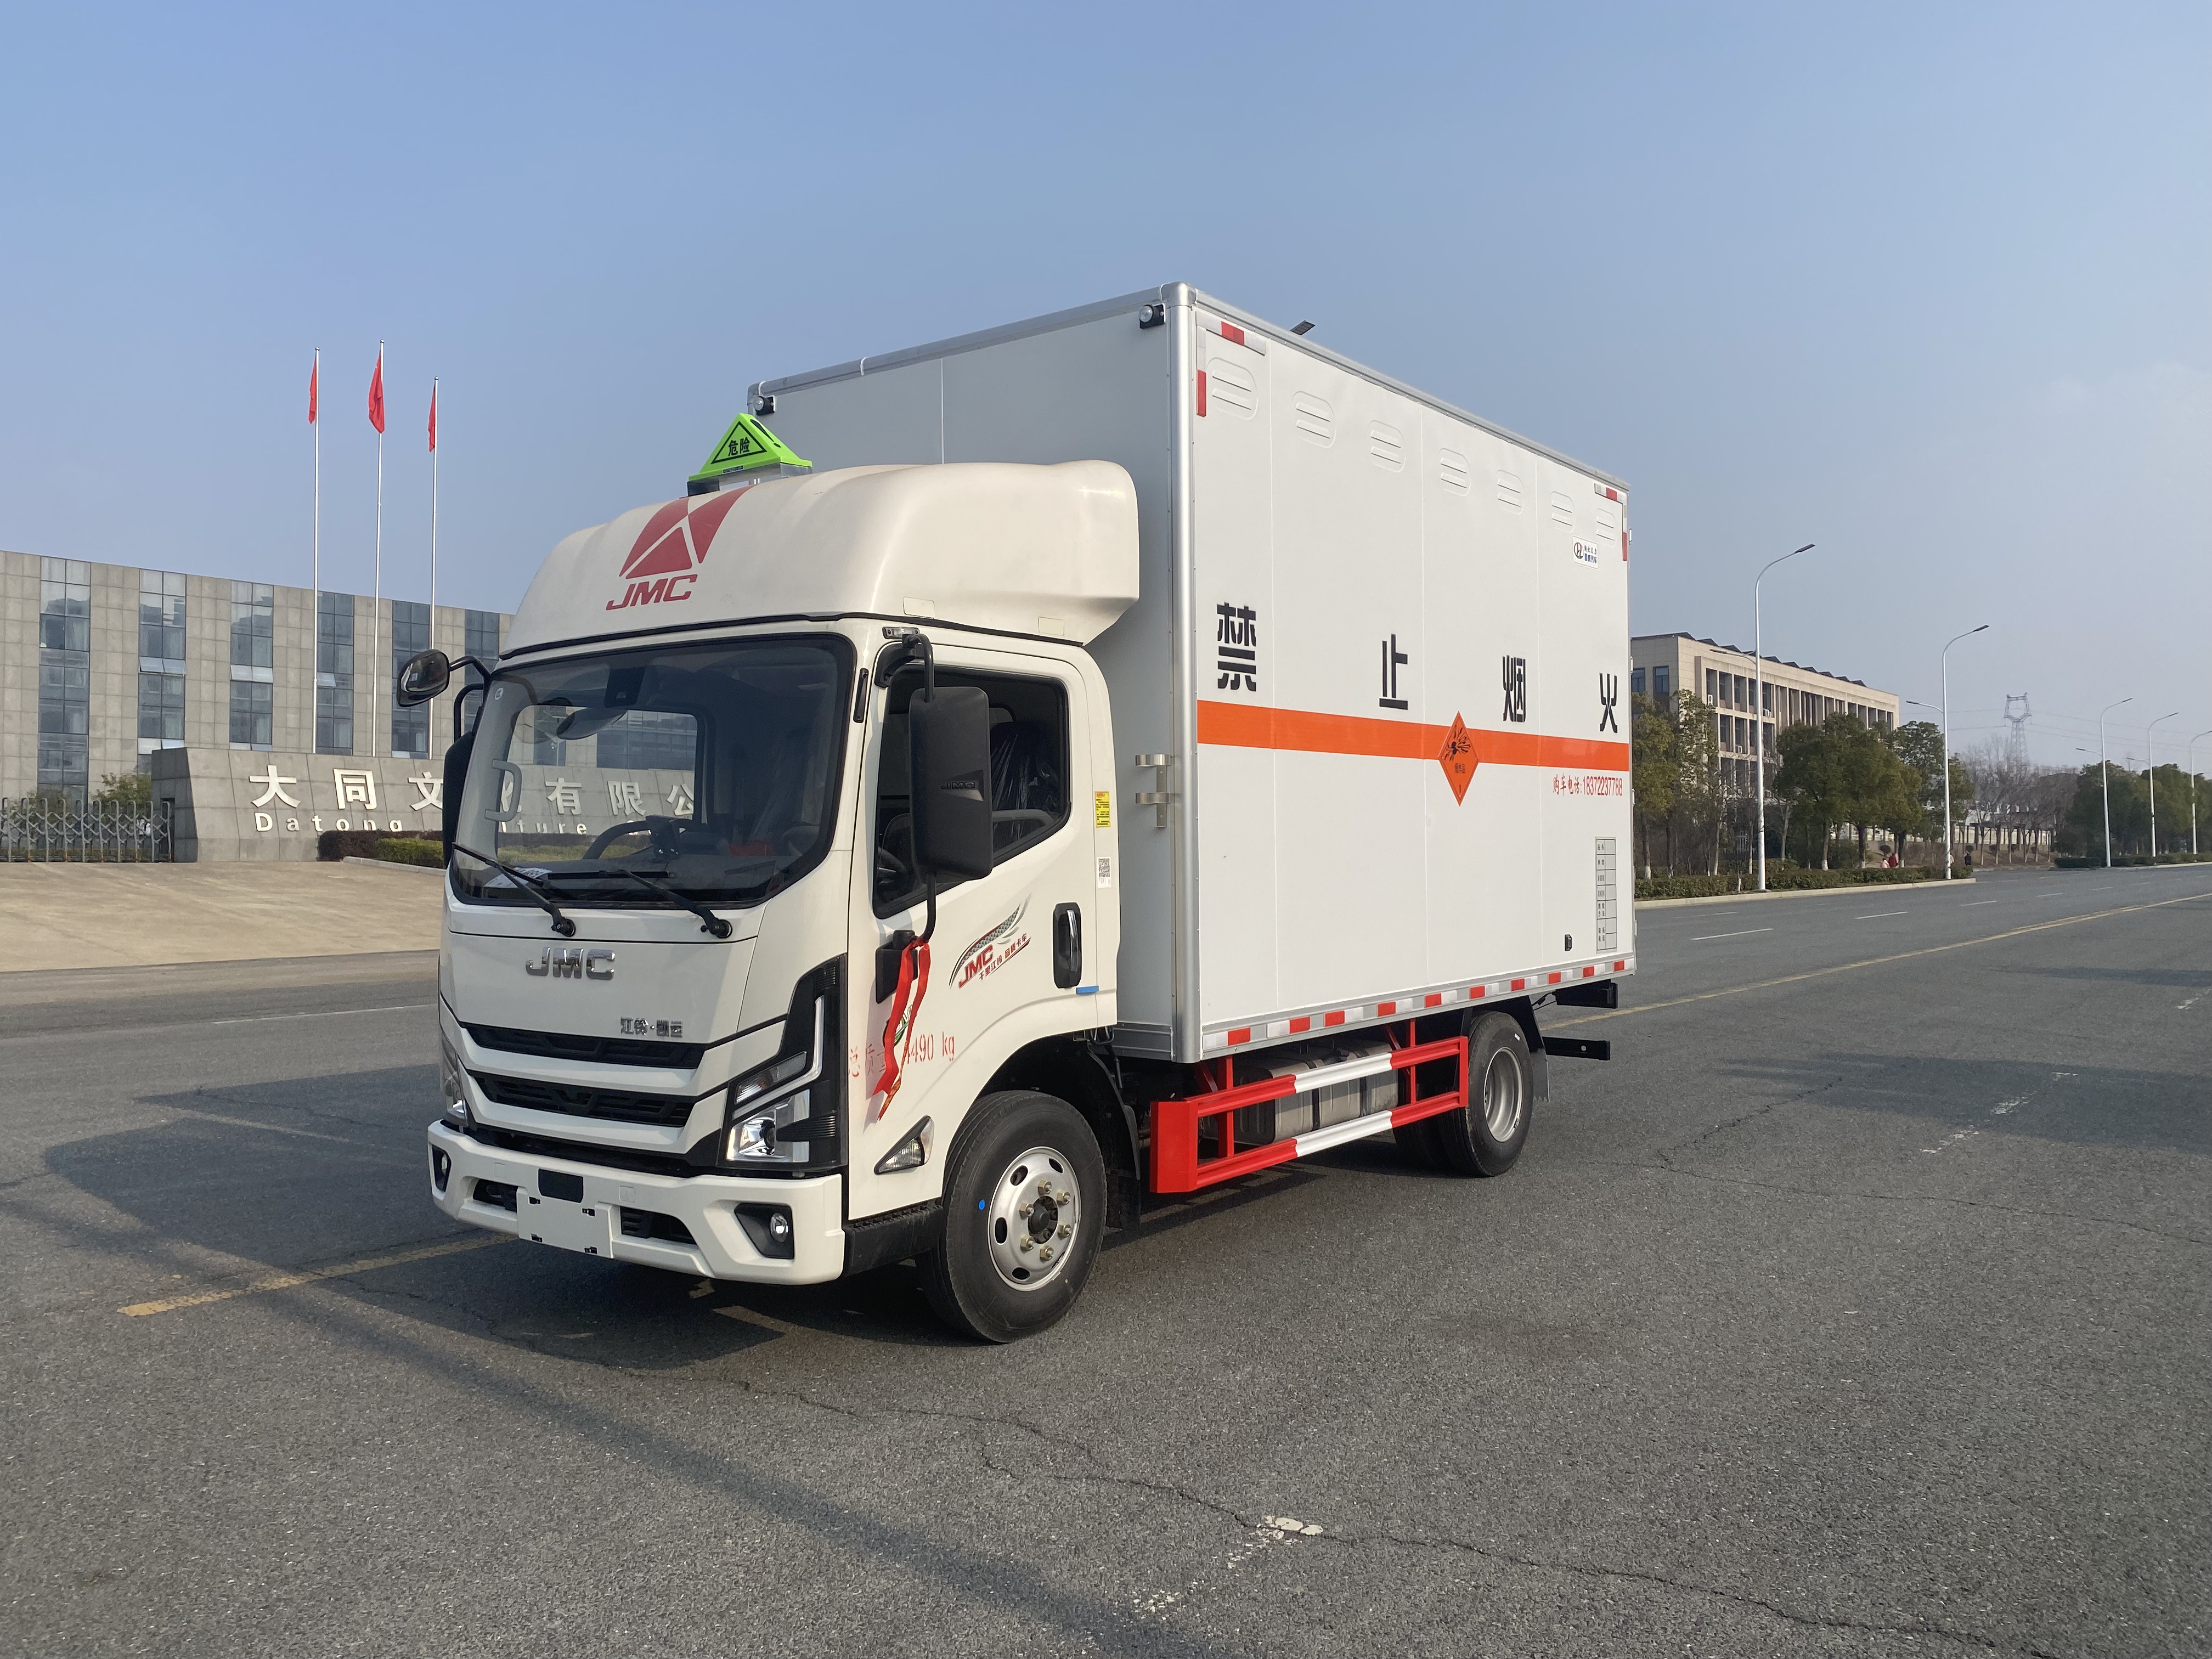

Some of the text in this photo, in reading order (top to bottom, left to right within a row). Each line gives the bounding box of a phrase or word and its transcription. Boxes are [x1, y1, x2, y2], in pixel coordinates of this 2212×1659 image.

[728, 437, 749, 456] 危险
[606, 574, 698, 610] JMC
[1217, 602, 1618, 733] 禁止烟火
[941, 781, 975, 789] JMC
[525, 946, 616, 980] JMC
[958, 944, 994, 989] JMC
[943, 1031, 955, 1062] kg
